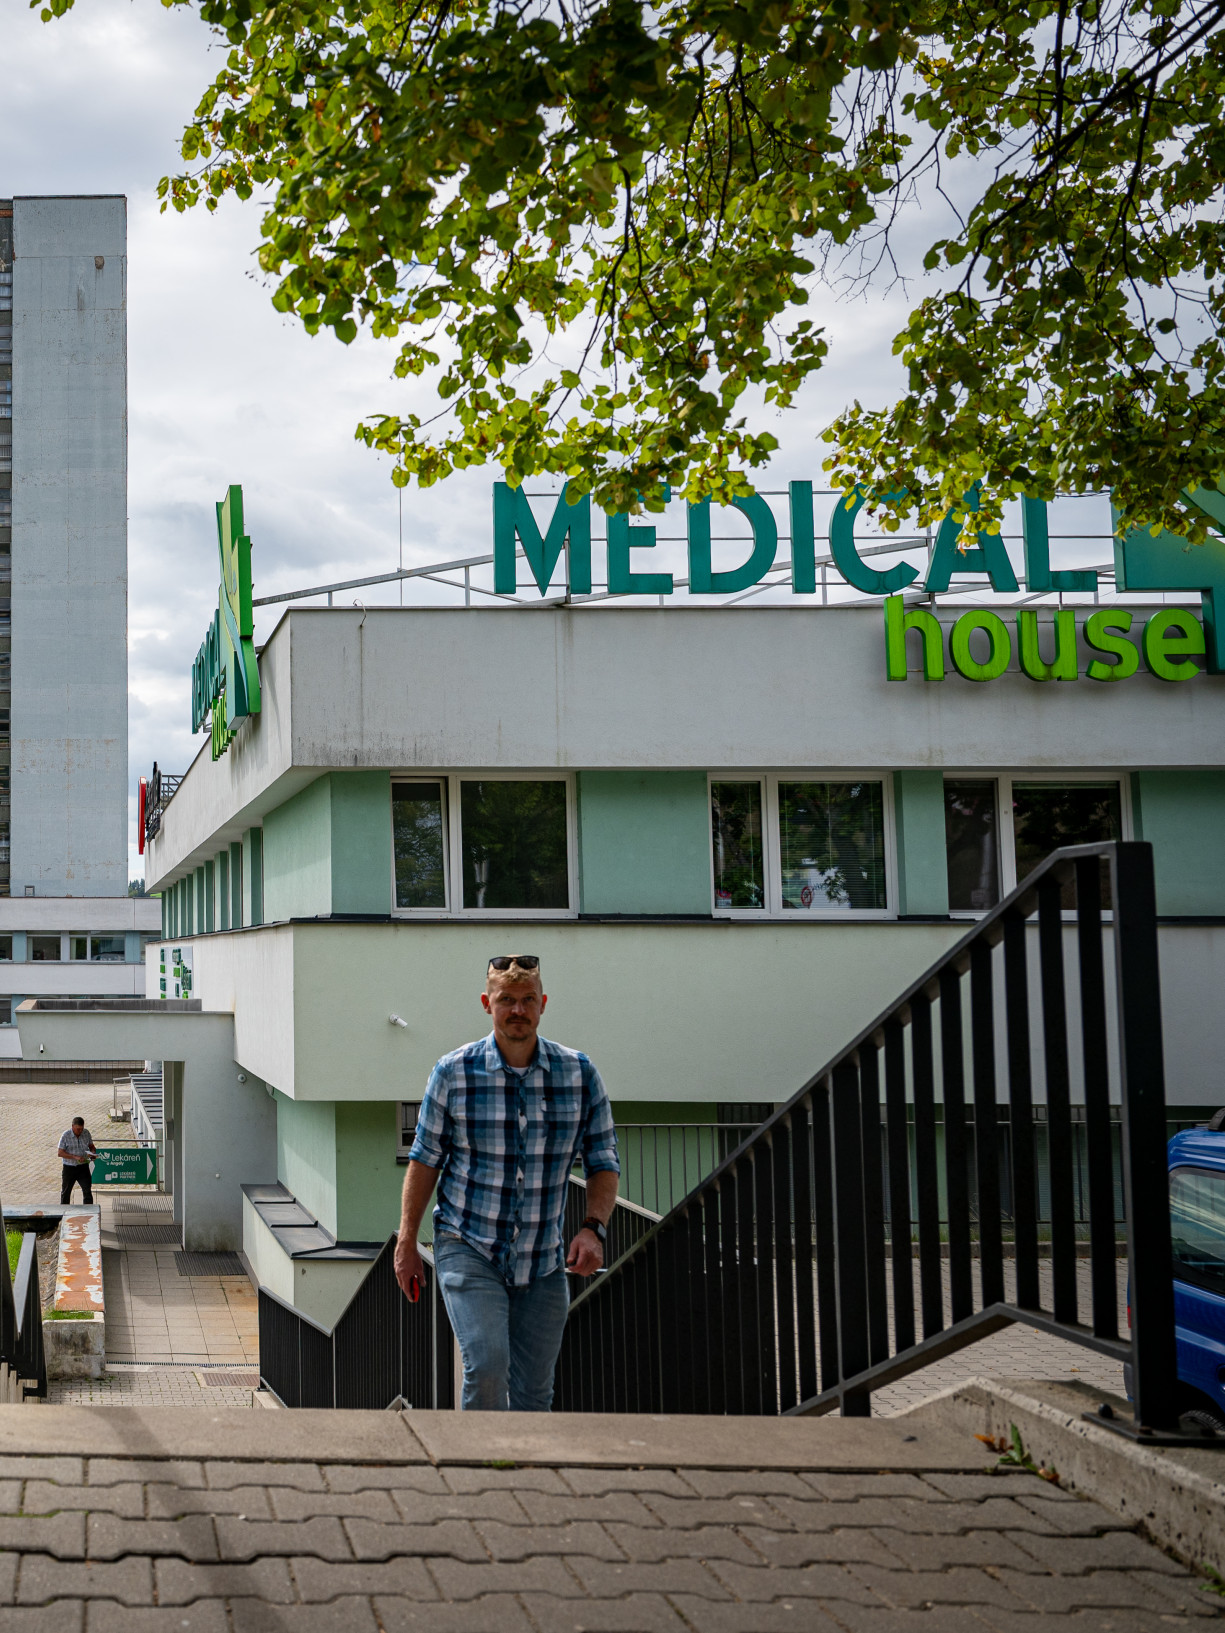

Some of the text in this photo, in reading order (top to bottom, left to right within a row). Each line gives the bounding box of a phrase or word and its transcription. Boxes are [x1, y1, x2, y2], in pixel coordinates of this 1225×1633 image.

[493, 480, 1098, 598] MEDICAL
[884, 594, 1207, 682] house
[111, 1153, 140, 1161] Lekáreň
